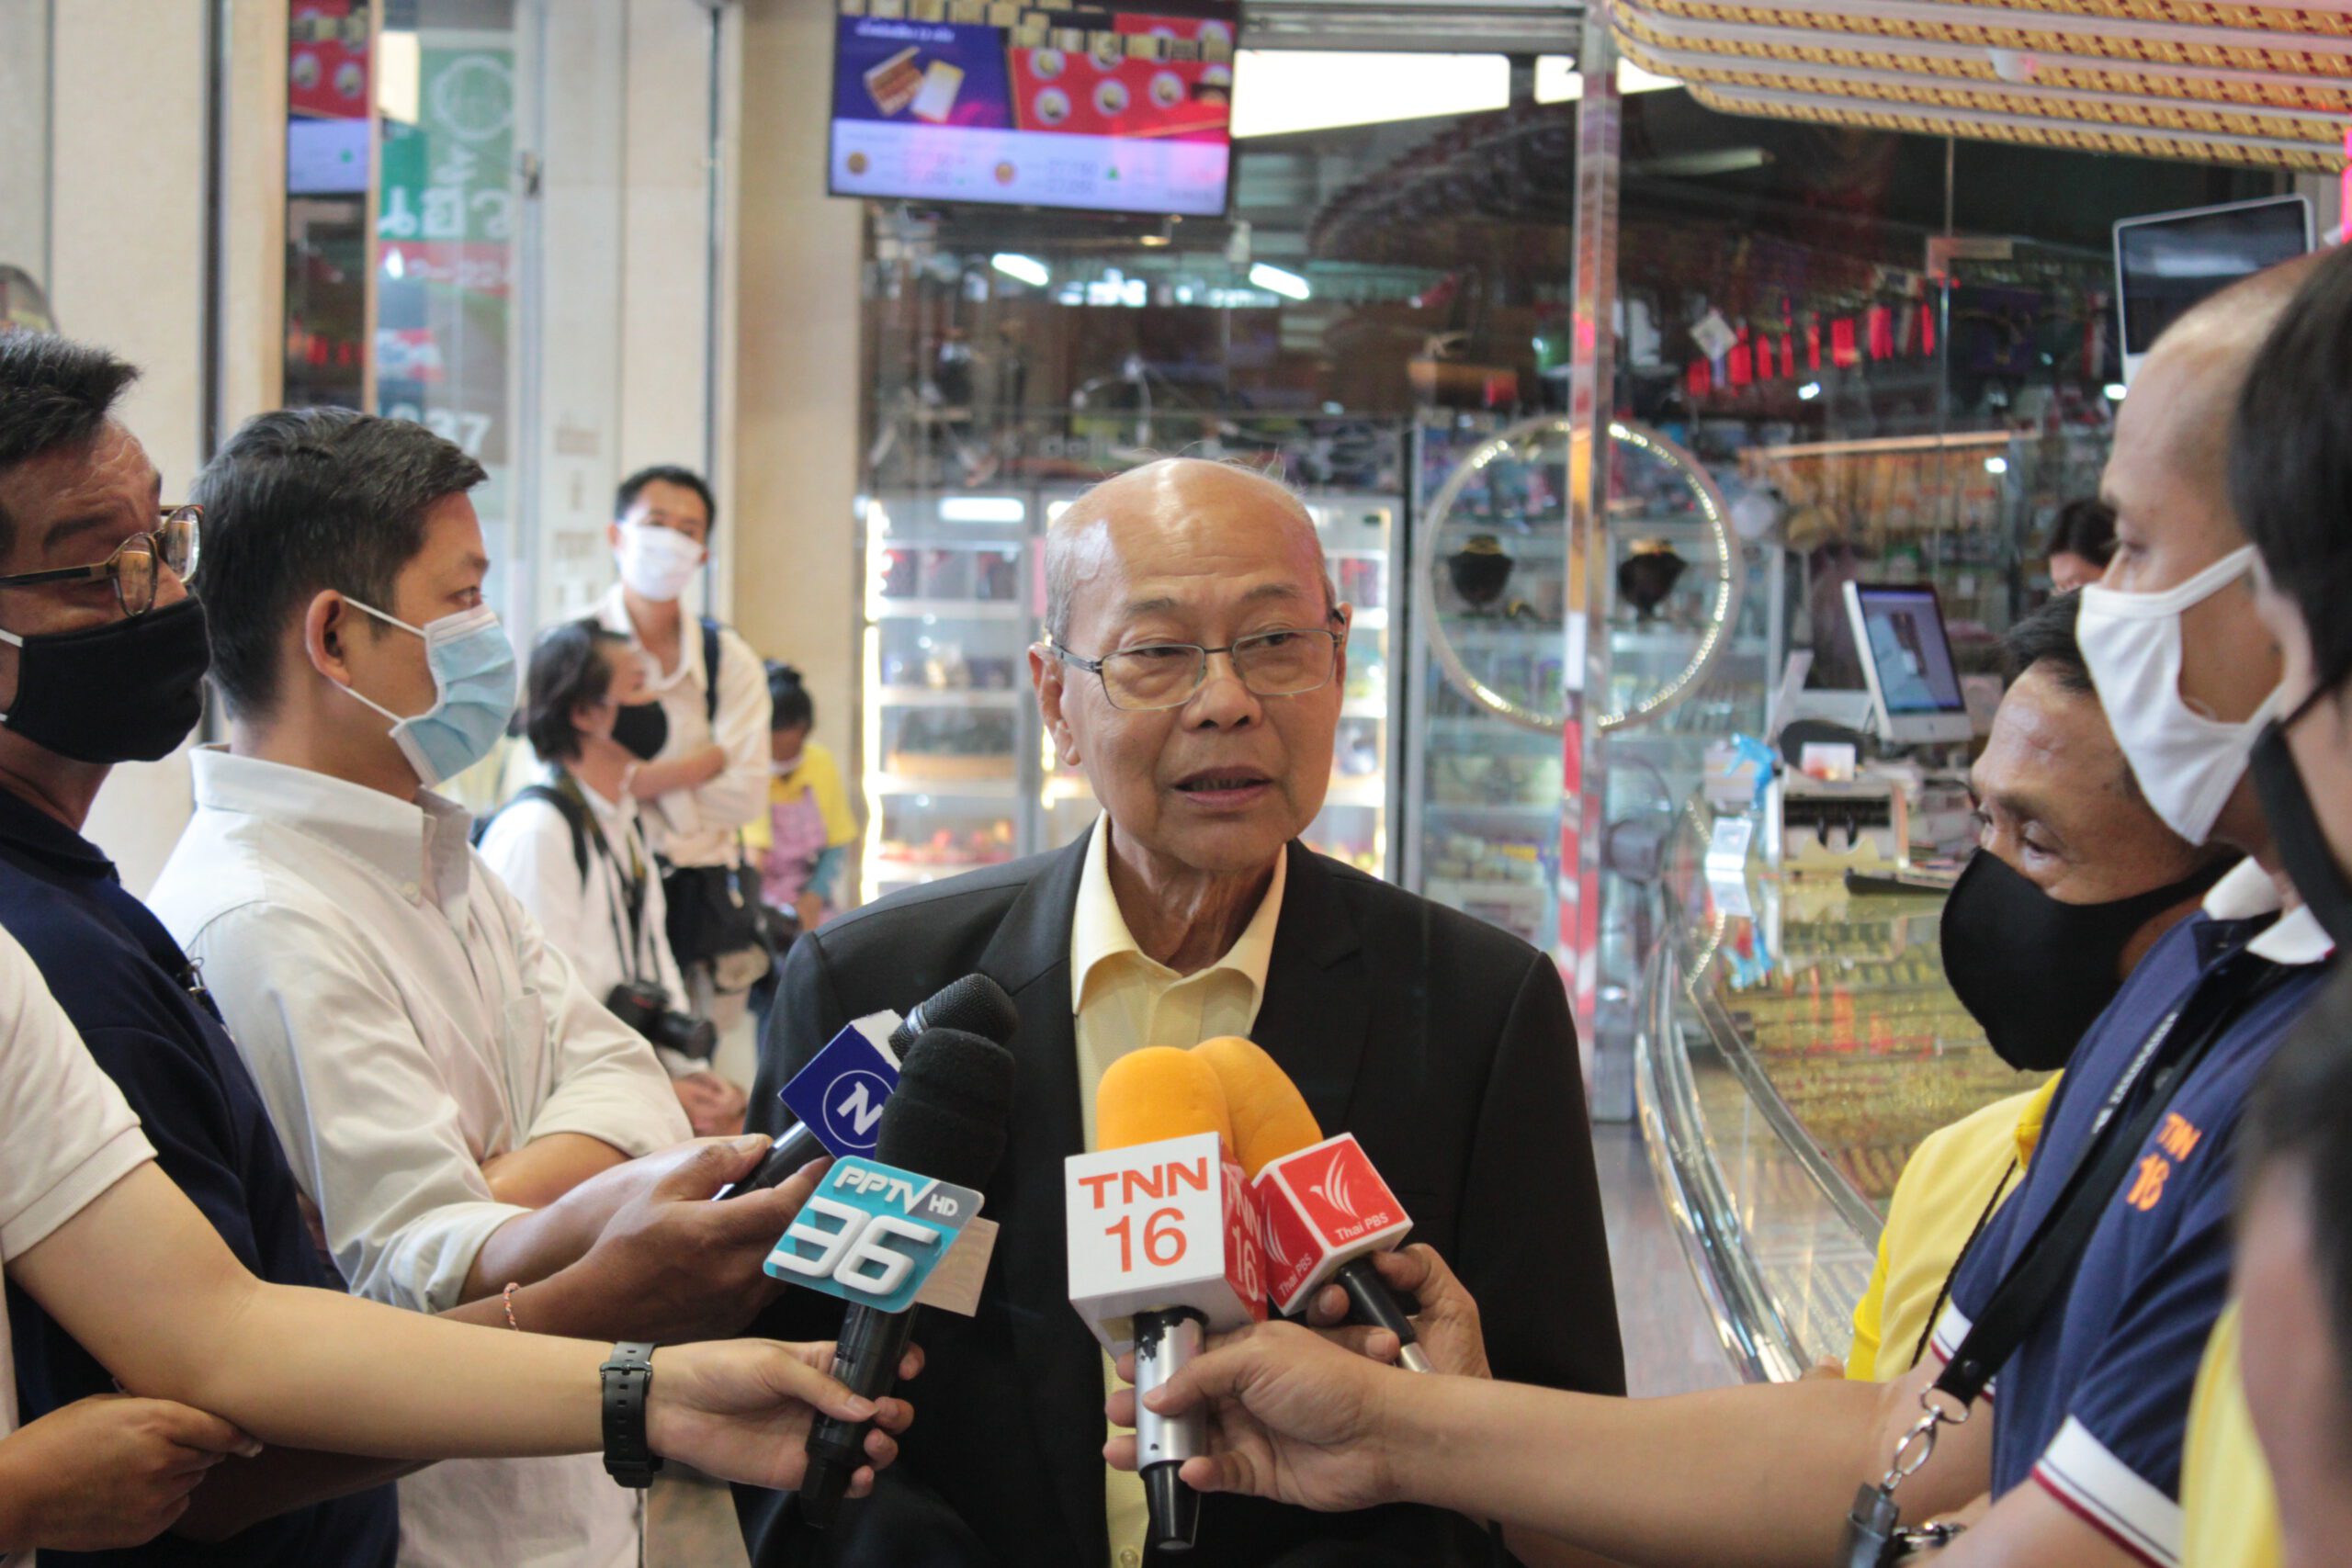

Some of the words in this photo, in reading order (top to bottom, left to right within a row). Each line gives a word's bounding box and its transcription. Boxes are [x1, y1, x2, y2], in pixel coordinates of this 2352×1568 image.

[837, 1080, 883, 1136] N
[832, 1165, 936, 1214] PPTV
[928, 1193, 958, 1217] HD
[1078, 1156, 1209, 1210] TNN
[767, 1195, 942, 1295] 36
[1104, 1207, 1188, 1273] 16
[1335, 1222, 1363, 1242] Thai
[1365, 1212, 1390, 1231] PBS
[1231, 1224, 1259, 1303] 16
[1278, 1271, 1298, 1298] Thai
[1295, 1253, 1314, 1278] PBS
